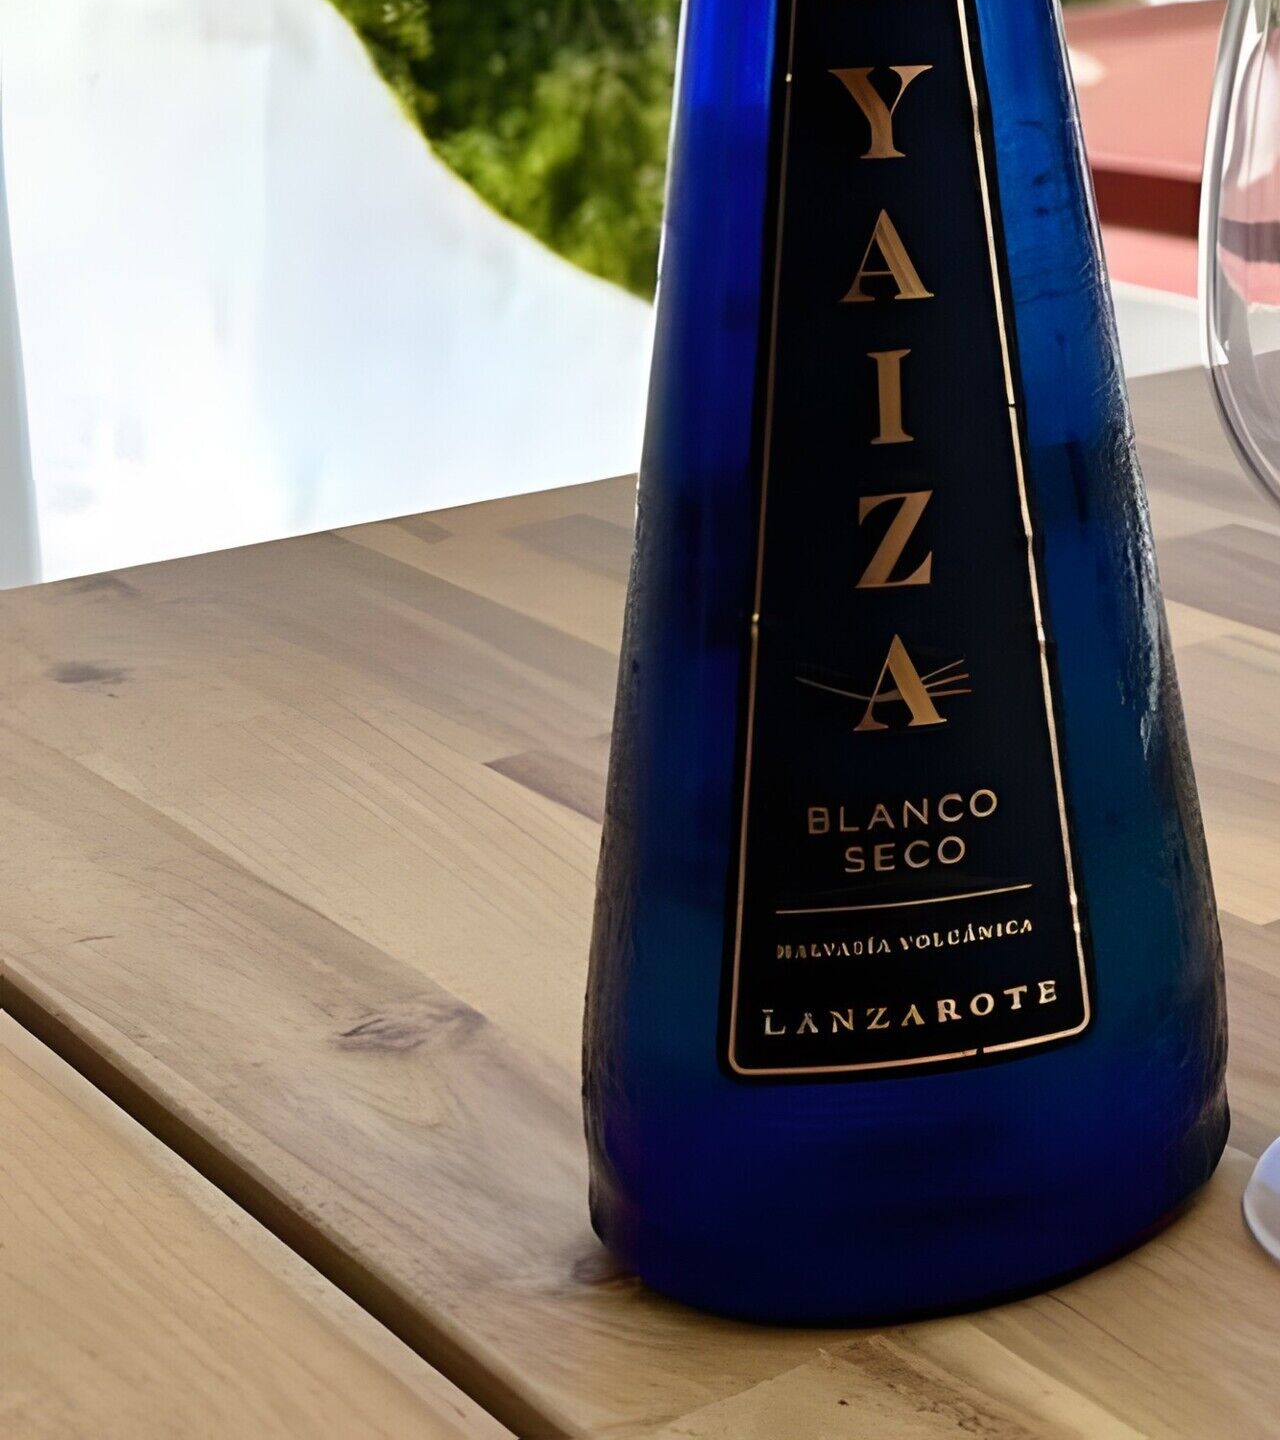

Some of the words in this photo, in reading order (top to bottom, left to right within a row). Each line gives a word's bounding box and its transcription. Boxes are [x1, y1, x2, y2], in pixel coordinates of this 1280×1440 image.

[829, 65, 948, 731] YAIZA
[807, 789, 998, 835] BLANCO
[844, 835, 966, 873] SECO
[762, 980, 1057, 1036] LANZAROTE
